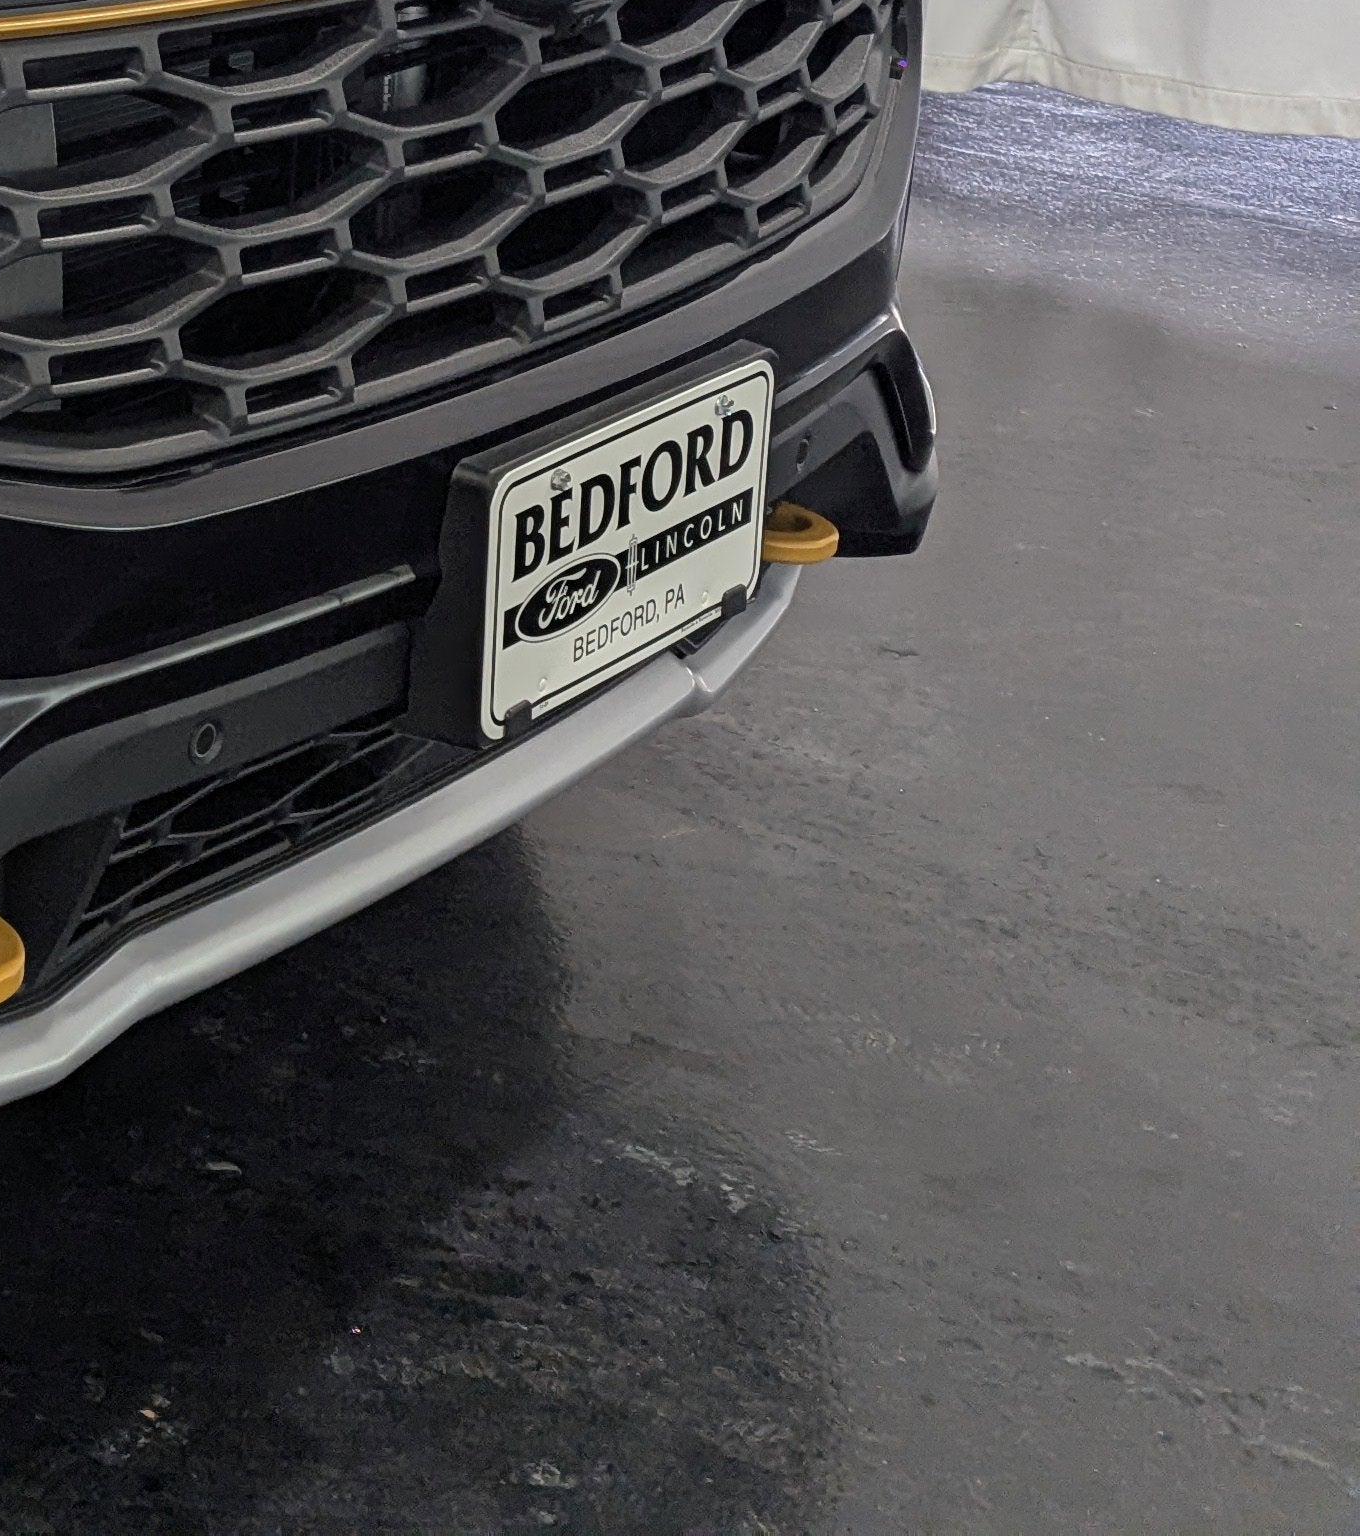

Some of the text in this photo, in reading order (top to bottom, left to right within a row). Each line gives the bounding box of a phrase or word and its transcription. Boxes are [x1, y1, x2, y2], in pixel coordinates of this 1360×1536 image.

[513, 409, 754, 583] BEDFORD
[640, 498, 744, 571] LINCOLN
[538, 568, 600, 629] Ford
[573, 598, 660, 663] BEDFORD,
[665, 582, 685, 614] PA
